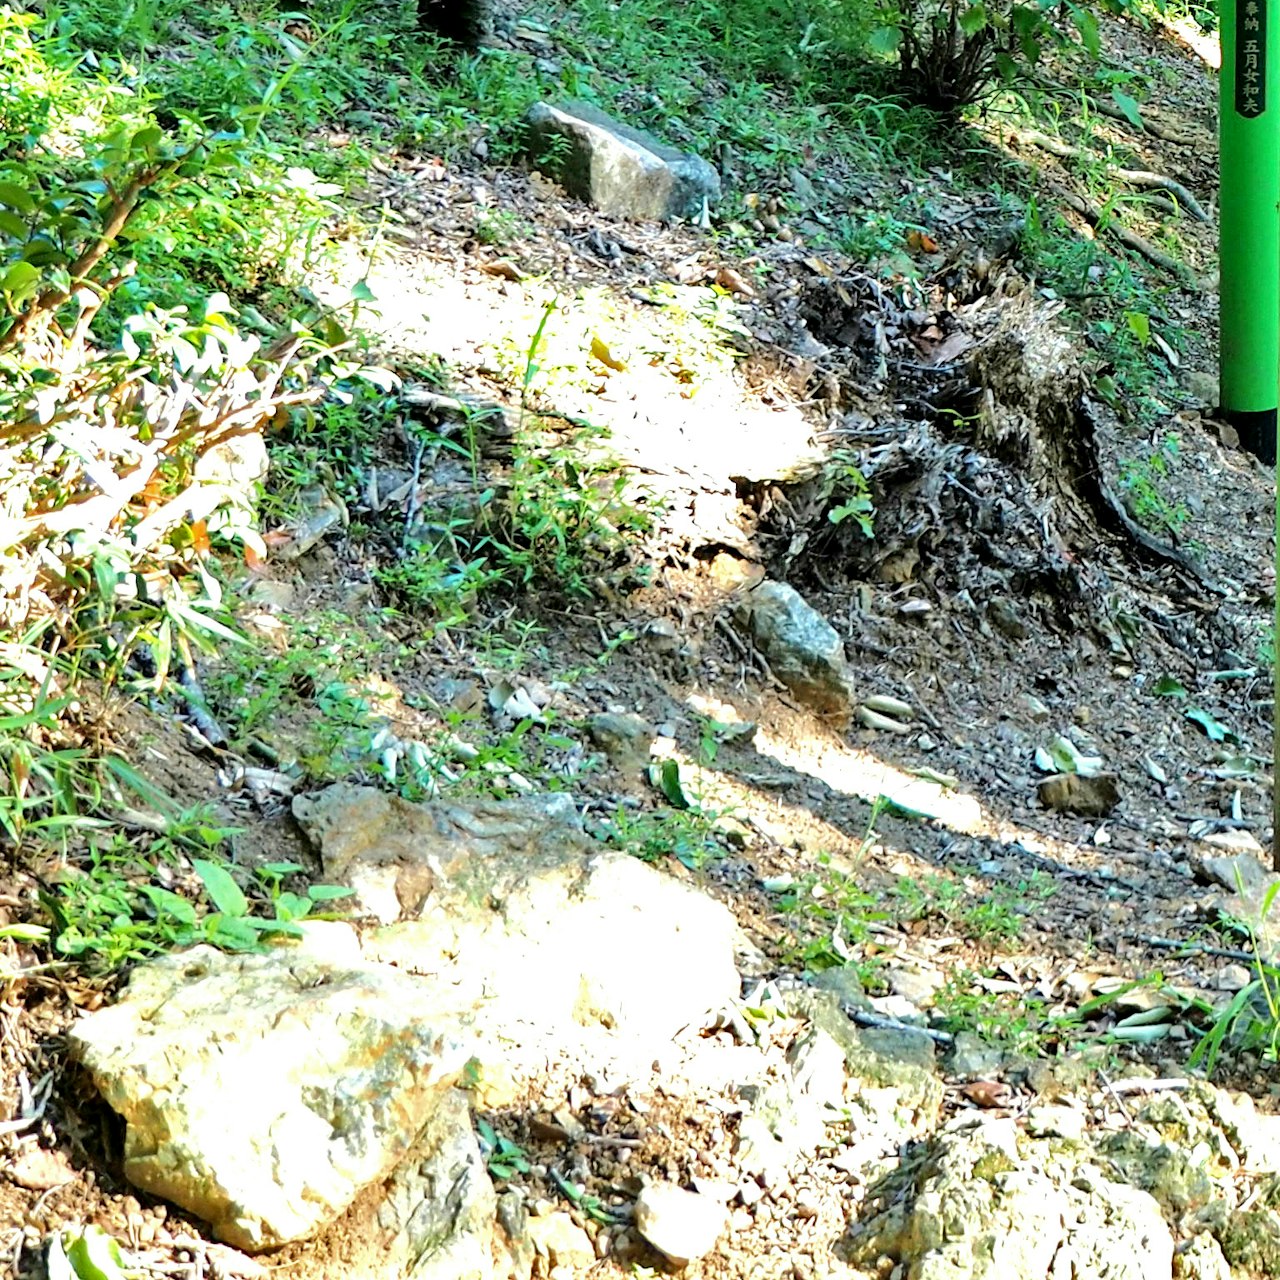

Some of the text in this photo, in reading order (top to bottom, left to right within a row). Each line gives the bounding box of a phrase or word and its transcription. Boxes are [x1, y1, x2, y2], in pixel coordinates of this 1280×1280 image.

[1243, 1, 1260, 113] 奉納 五月女和夫
